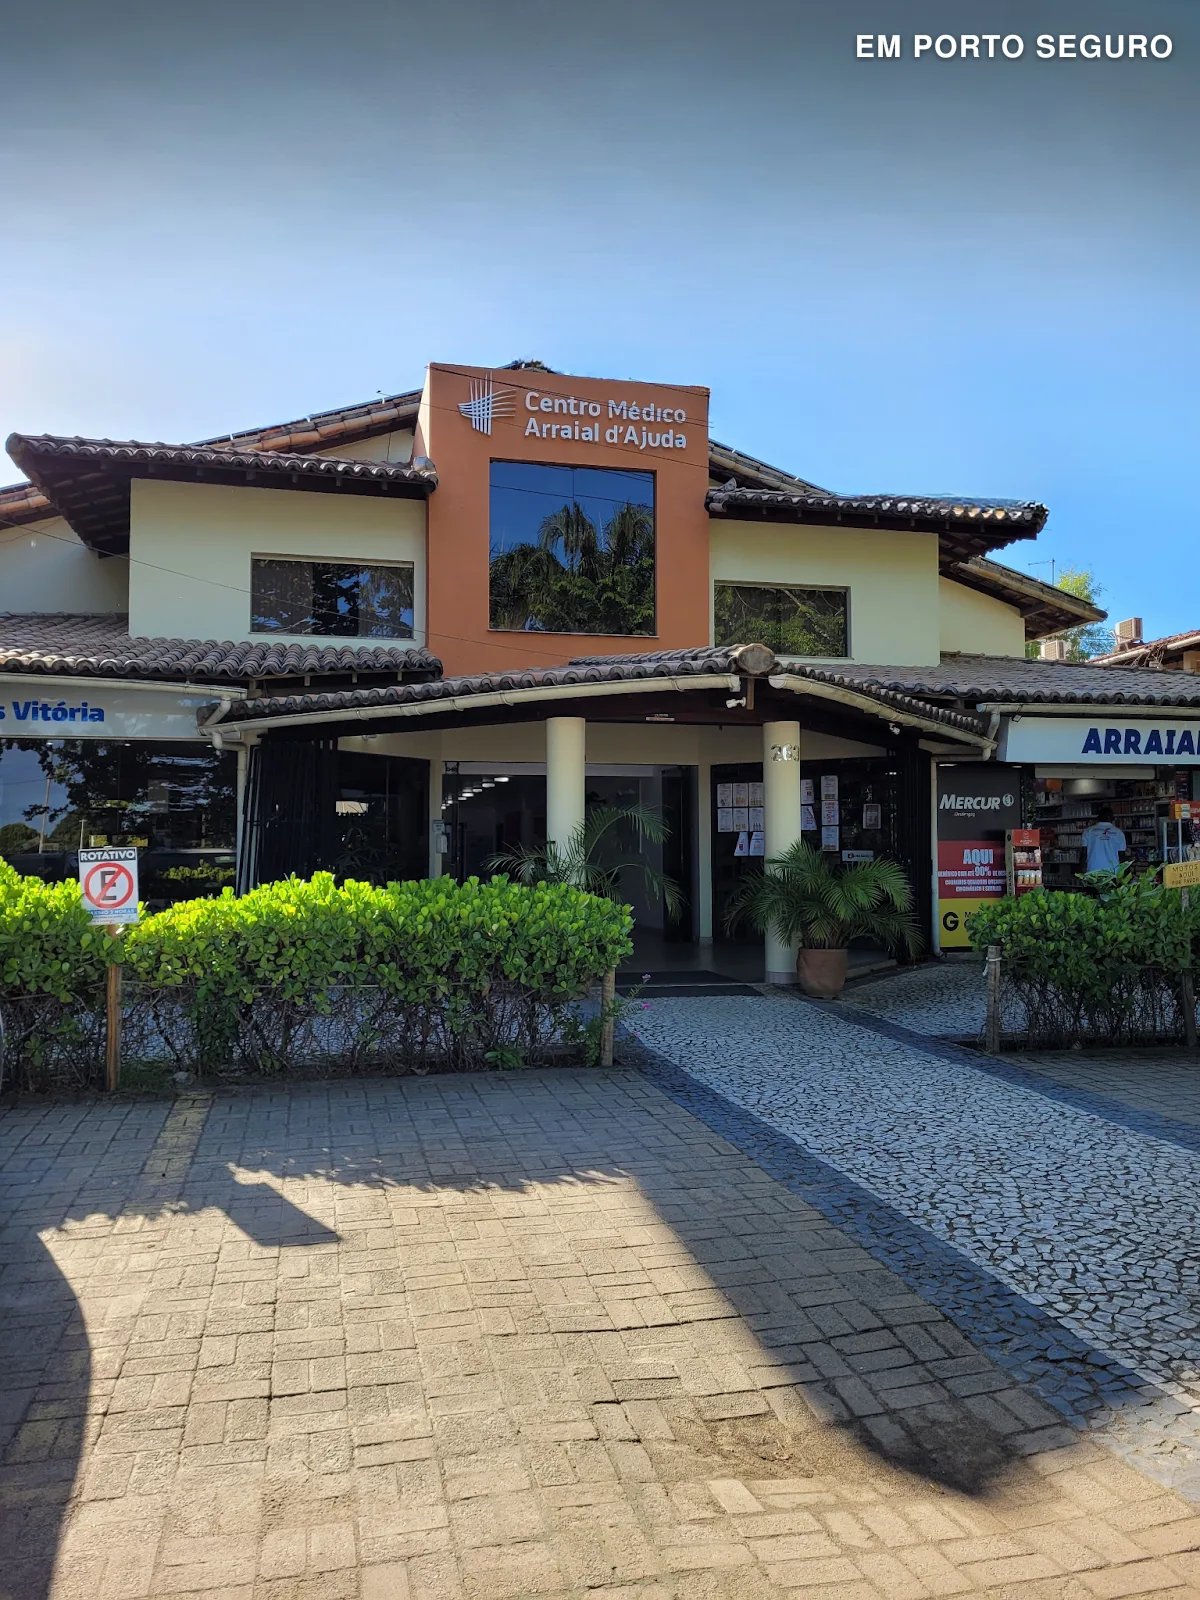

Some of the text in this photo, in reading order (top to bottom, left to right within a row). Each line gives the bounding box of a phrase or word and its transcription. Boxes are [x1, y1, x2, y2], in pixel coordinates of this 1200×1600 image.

[525, 391, 687, 424] Centro Médico
[524, 417, 600, 442] Arraial
[12, 700, 105, 722] Vitória
[1081, 728, 1200, 755] ARRAIA
[80, 850, 135, 861] ROTATIVO
[963, 849, 994, 866] AQUI
[975, 866, 992, 877] 90%
[1172, 863, 1198, 872] MOTOS
[1179, 870, 1194, 878] AQUI
[942, 911, 959, 931] G
